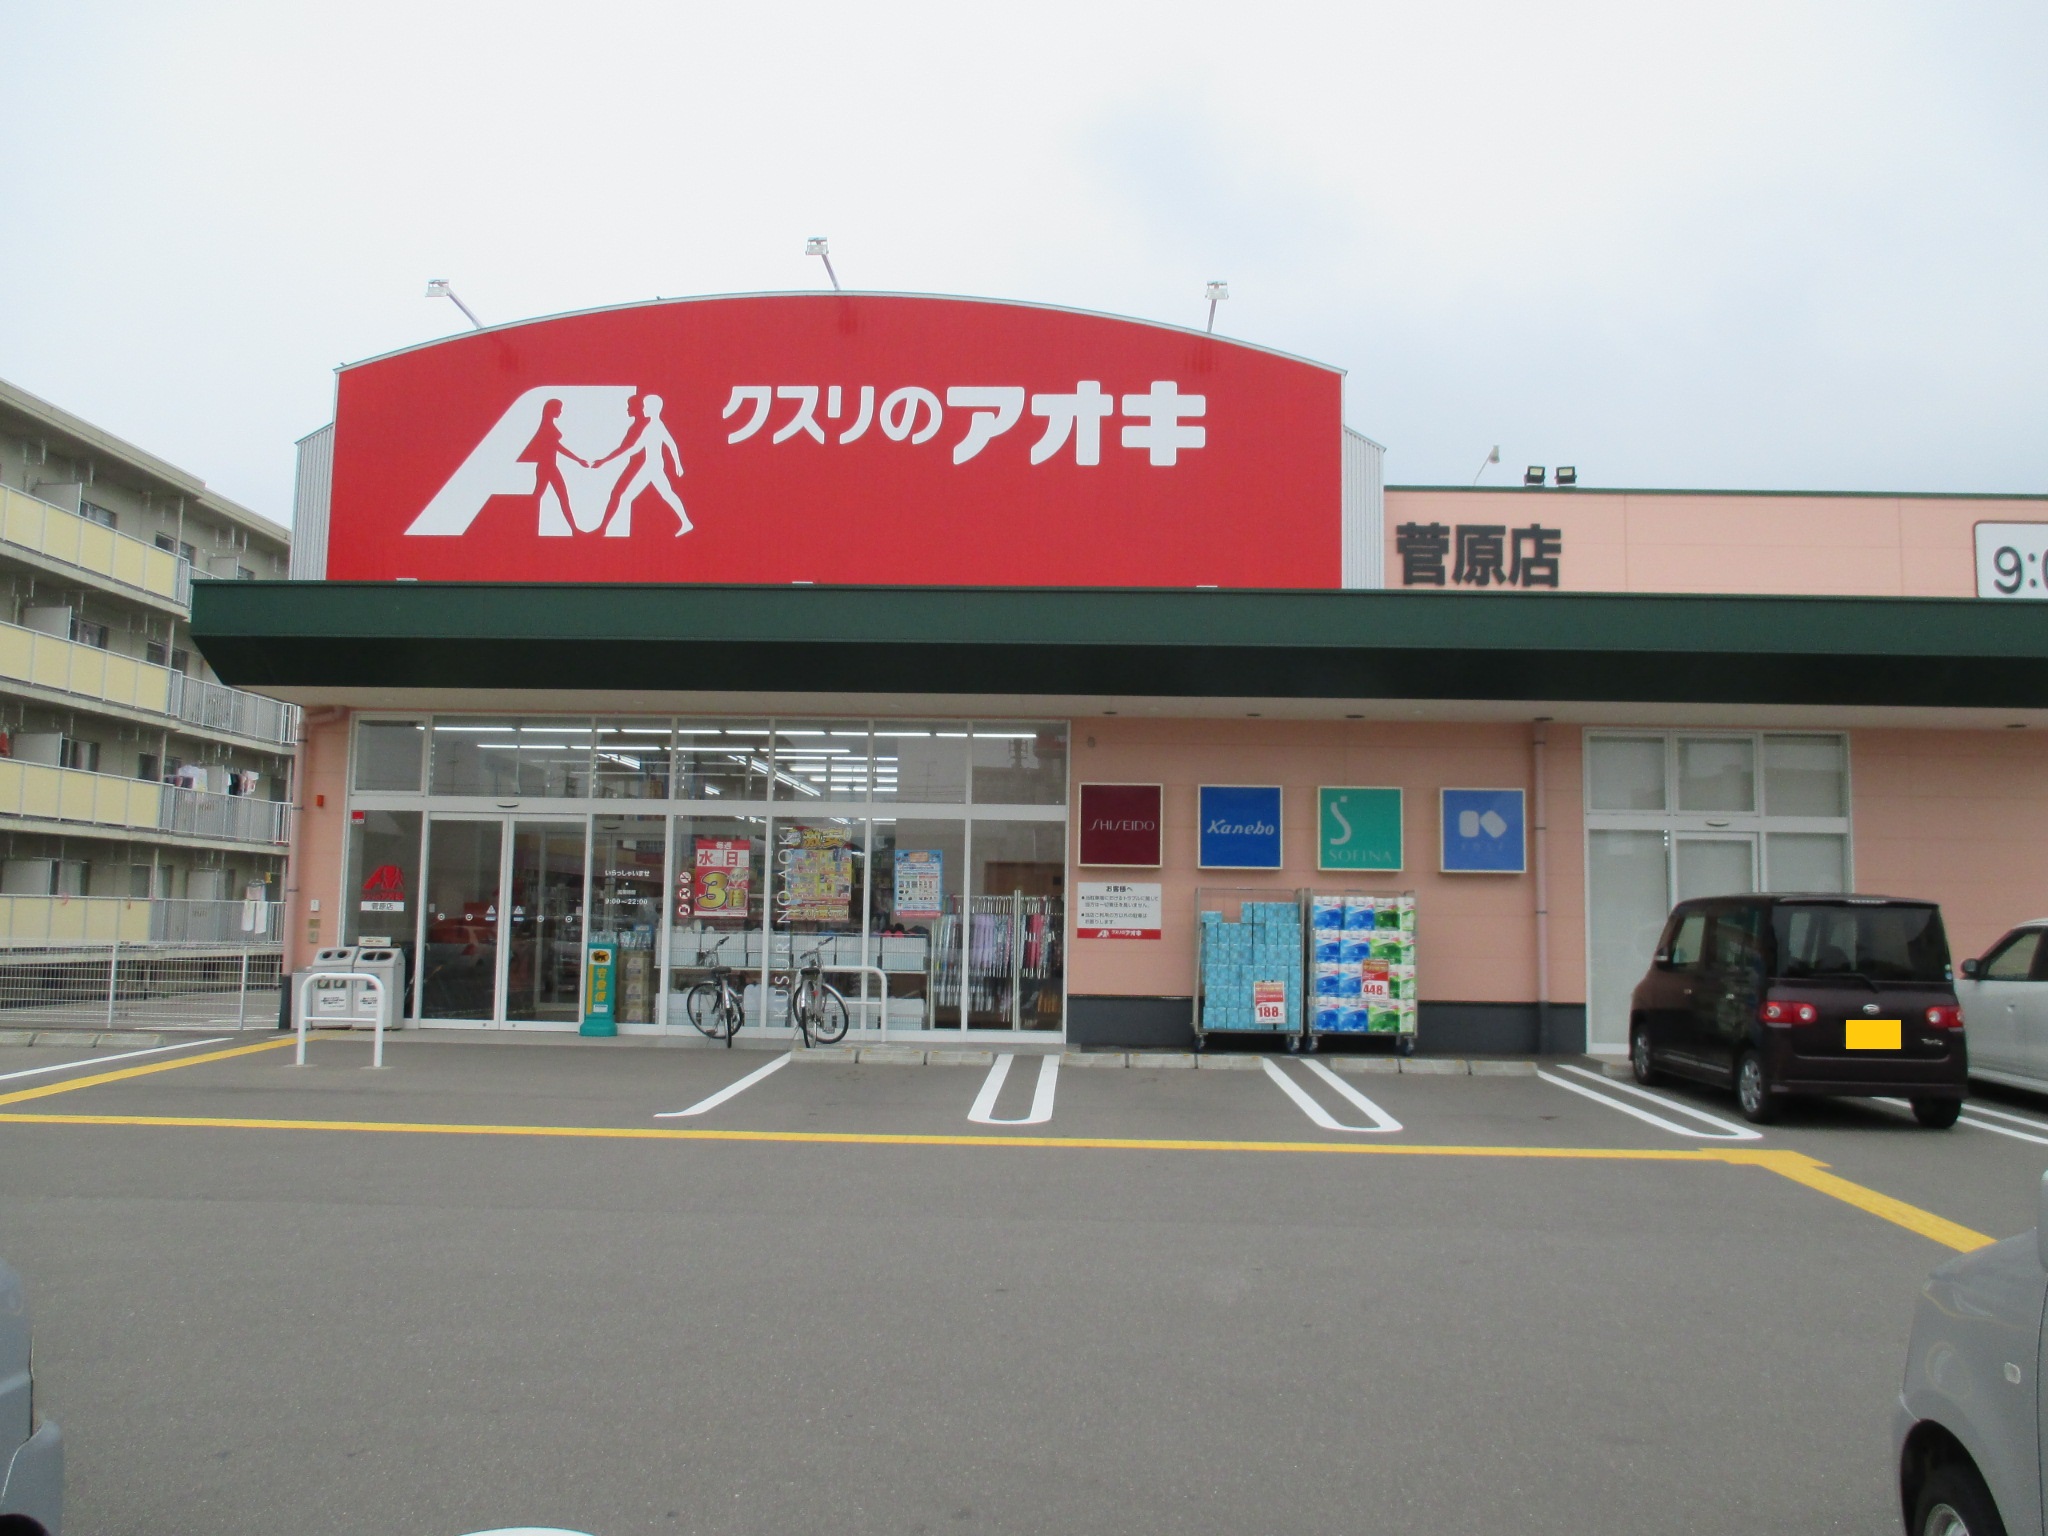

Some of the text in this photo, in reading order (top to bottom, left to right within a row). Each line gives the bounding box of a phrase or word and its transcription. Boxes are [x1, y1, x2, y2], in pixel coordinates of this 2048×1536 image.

[722, 380, 1207, 467] クスリのアオキ
[1396, 521, 1562, 587] 菅原店
[1993, 545, 2048, 595] 9:
[1089, 819, 1155, 831] SHISEIDO
[1207, 819, 1275, 835] Kanebo
[1329, 850, 1393, 863] SOFINA
[696, 871, 729, 910] 3
[1106, 885, 1134, 893] お客様へ
[1363, 984, 1383, 996] 448
[1257, 1006, 1279, 1018] 188
